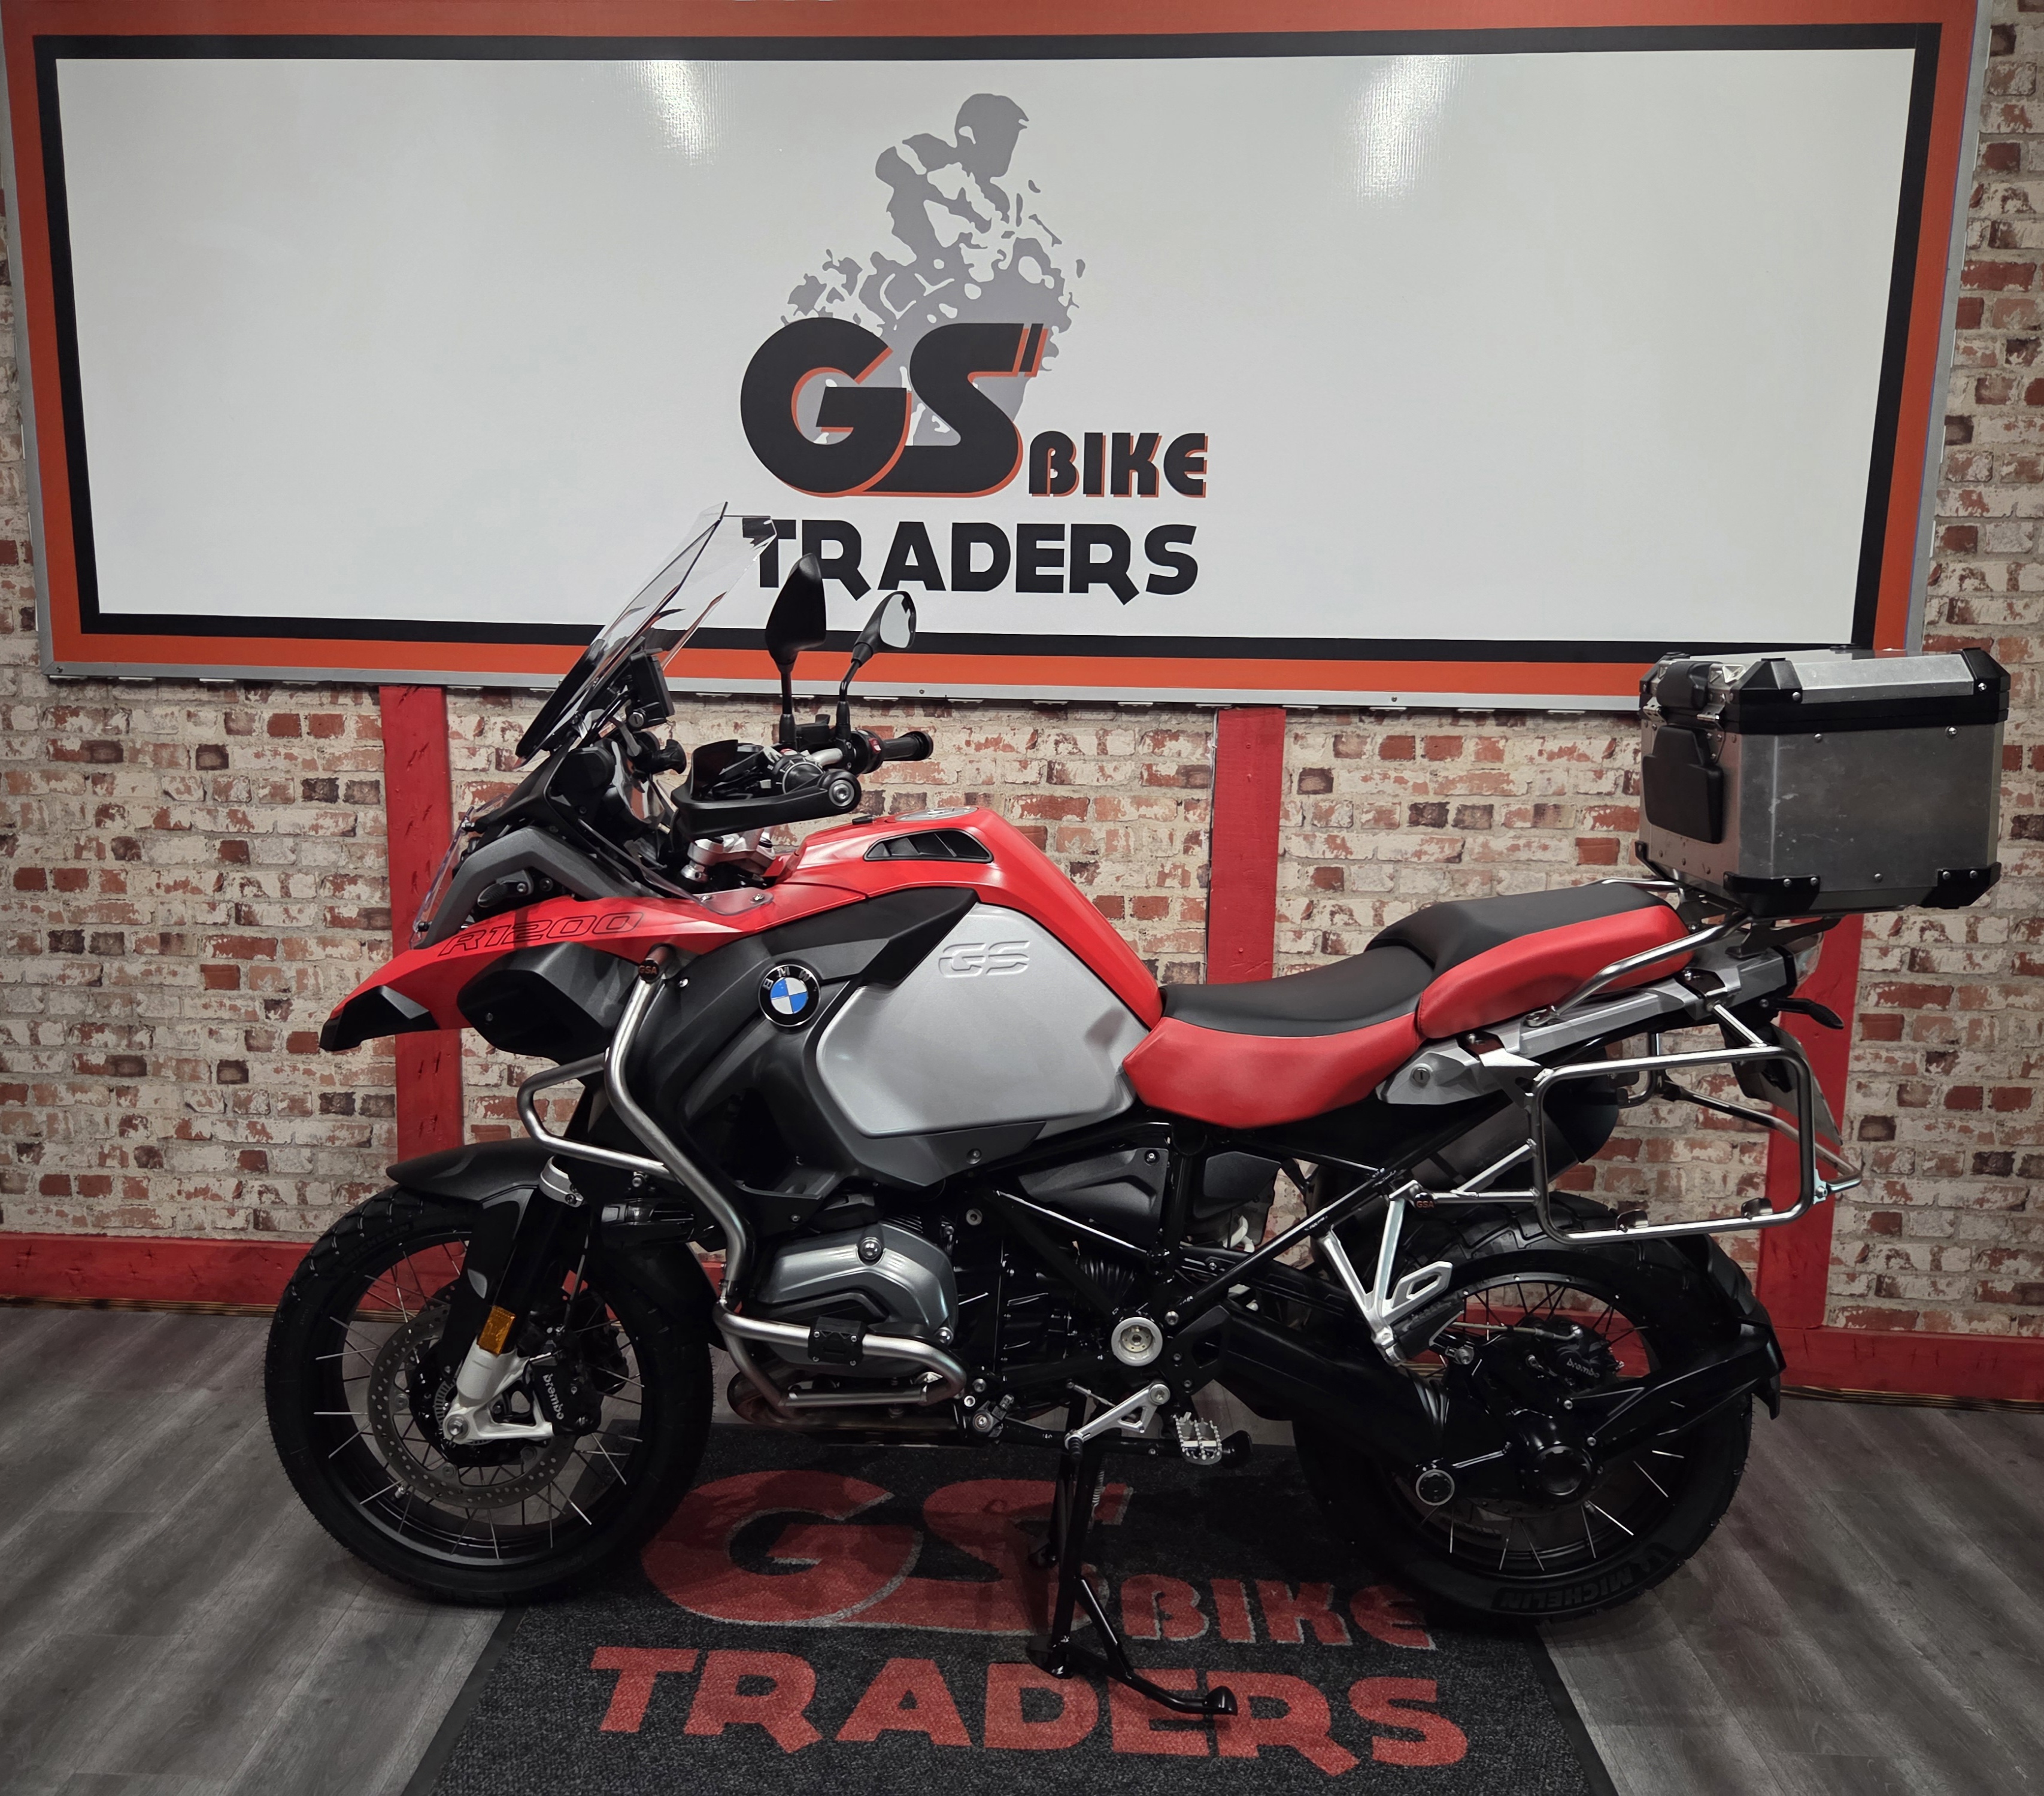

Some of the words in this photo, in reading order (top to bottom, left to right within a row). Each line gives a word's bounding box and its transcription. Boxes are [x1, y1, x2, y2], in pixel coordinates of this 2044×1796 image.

[740, 317, 1049, 498] GS
[1029, 430, 1208, 498] BIKE
[742, 518, 1199, 605] TRADERS
[438, 911, 645, 957] R1200
[639, 964, 657, 975] GSA
[762, 966, 811, 991] BMW
[938, 941, 1030, 978] GS
[1416, 1200, 1435, 1209] GSA
[1566, 1357, 1600, 1378] brembo
[542, 1373, 565, 1420] brembo
[639, 1469, 1134, 1636] GS
[1121, 1573, 1437, 1650] BIKE
[1499, 1567, 1634, 1610] MICHELIN
[590, 1645, 1469, 1776] TRADERS
